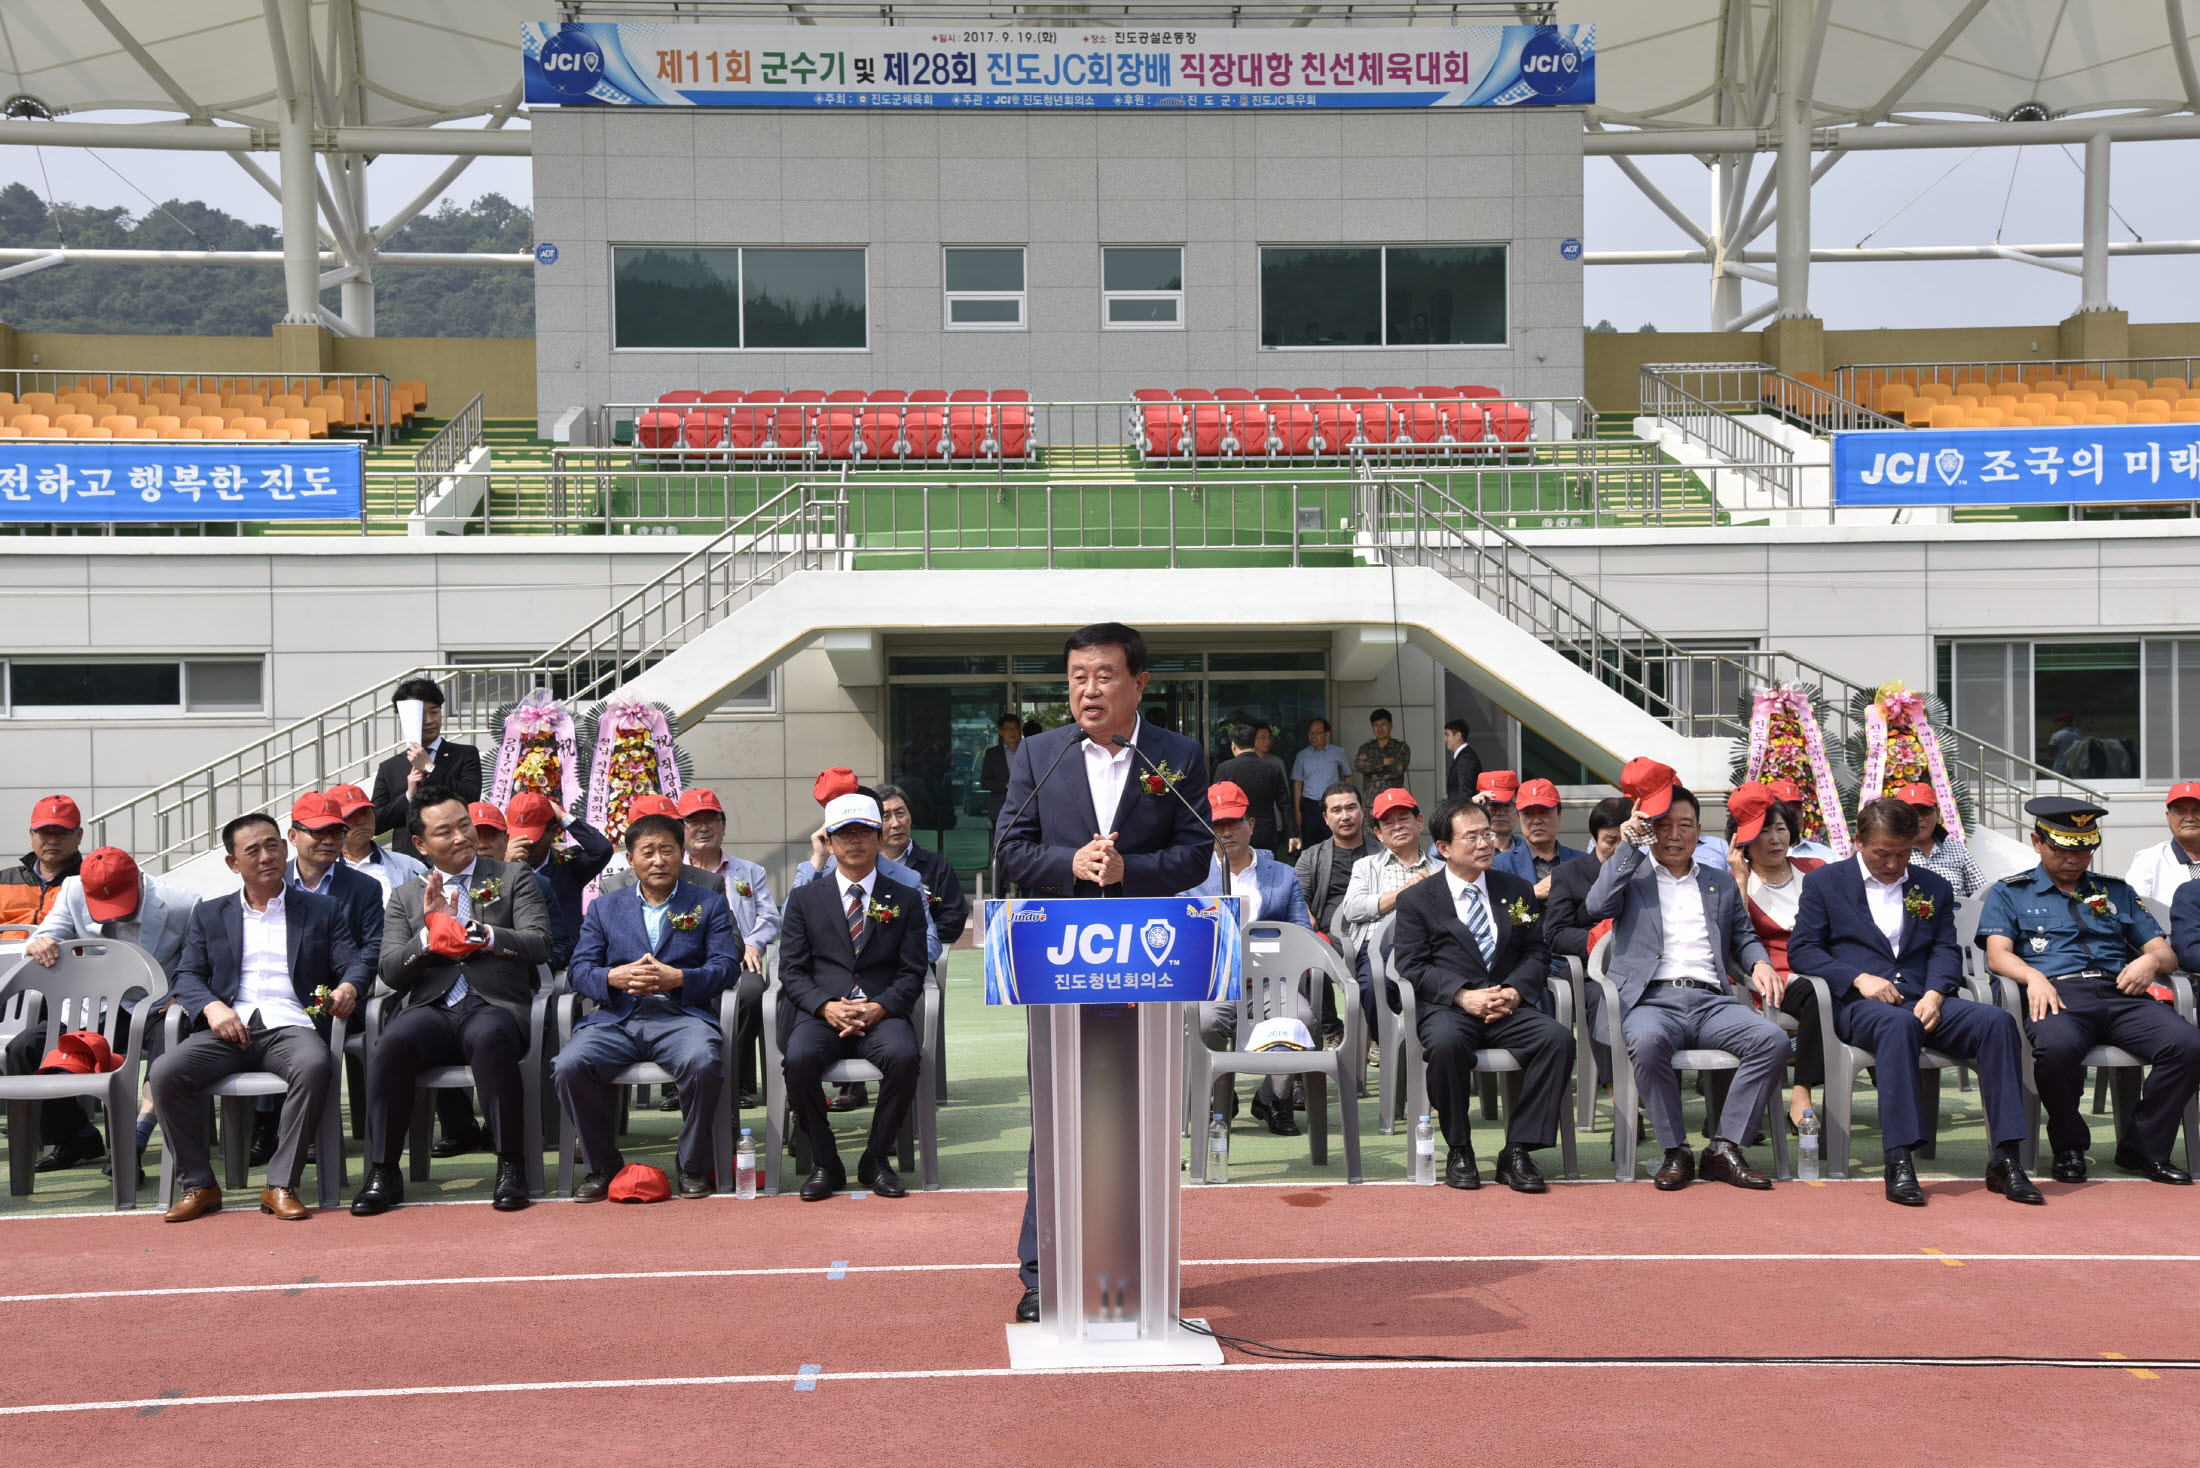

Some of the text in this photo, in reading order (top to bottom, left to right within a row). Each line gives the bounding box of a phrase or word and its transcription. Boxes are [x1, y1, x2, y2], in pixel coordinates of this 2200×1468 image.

[963, 31, 999, 43] 2017.
[1115, 31, 1197, 44] 진도공설운동장
[544, 53, 580, 71] JCI
[656, 49, 1469, 87] 제11회 군수기 및 제28회 진도JC회장배 직장대항 친선체육대회
[1524, 54, 1559, 73] JCI
[871, 93, 933, 106] 진도군체육회
[994, 95, 1011, 105] JCI
[1022, 94, 1095, 106] 진도청년회의소
[1251, 94, 1316, 106] 진도JC특우회
[539, 249, 556, 258] ADT
[1564, 245, 1579, 253] ADT
[1861, 452, 1930, 485] JCI
[1980, 443, 2104, 486] 조국의
[0, 463, 337, 503] 전하고 행복한 진도
[560, 737, 576, 759] 祝
[1047, 923, 1133, 966] JCI
[1054, 971, 1174, 991] 진도청년회의소
